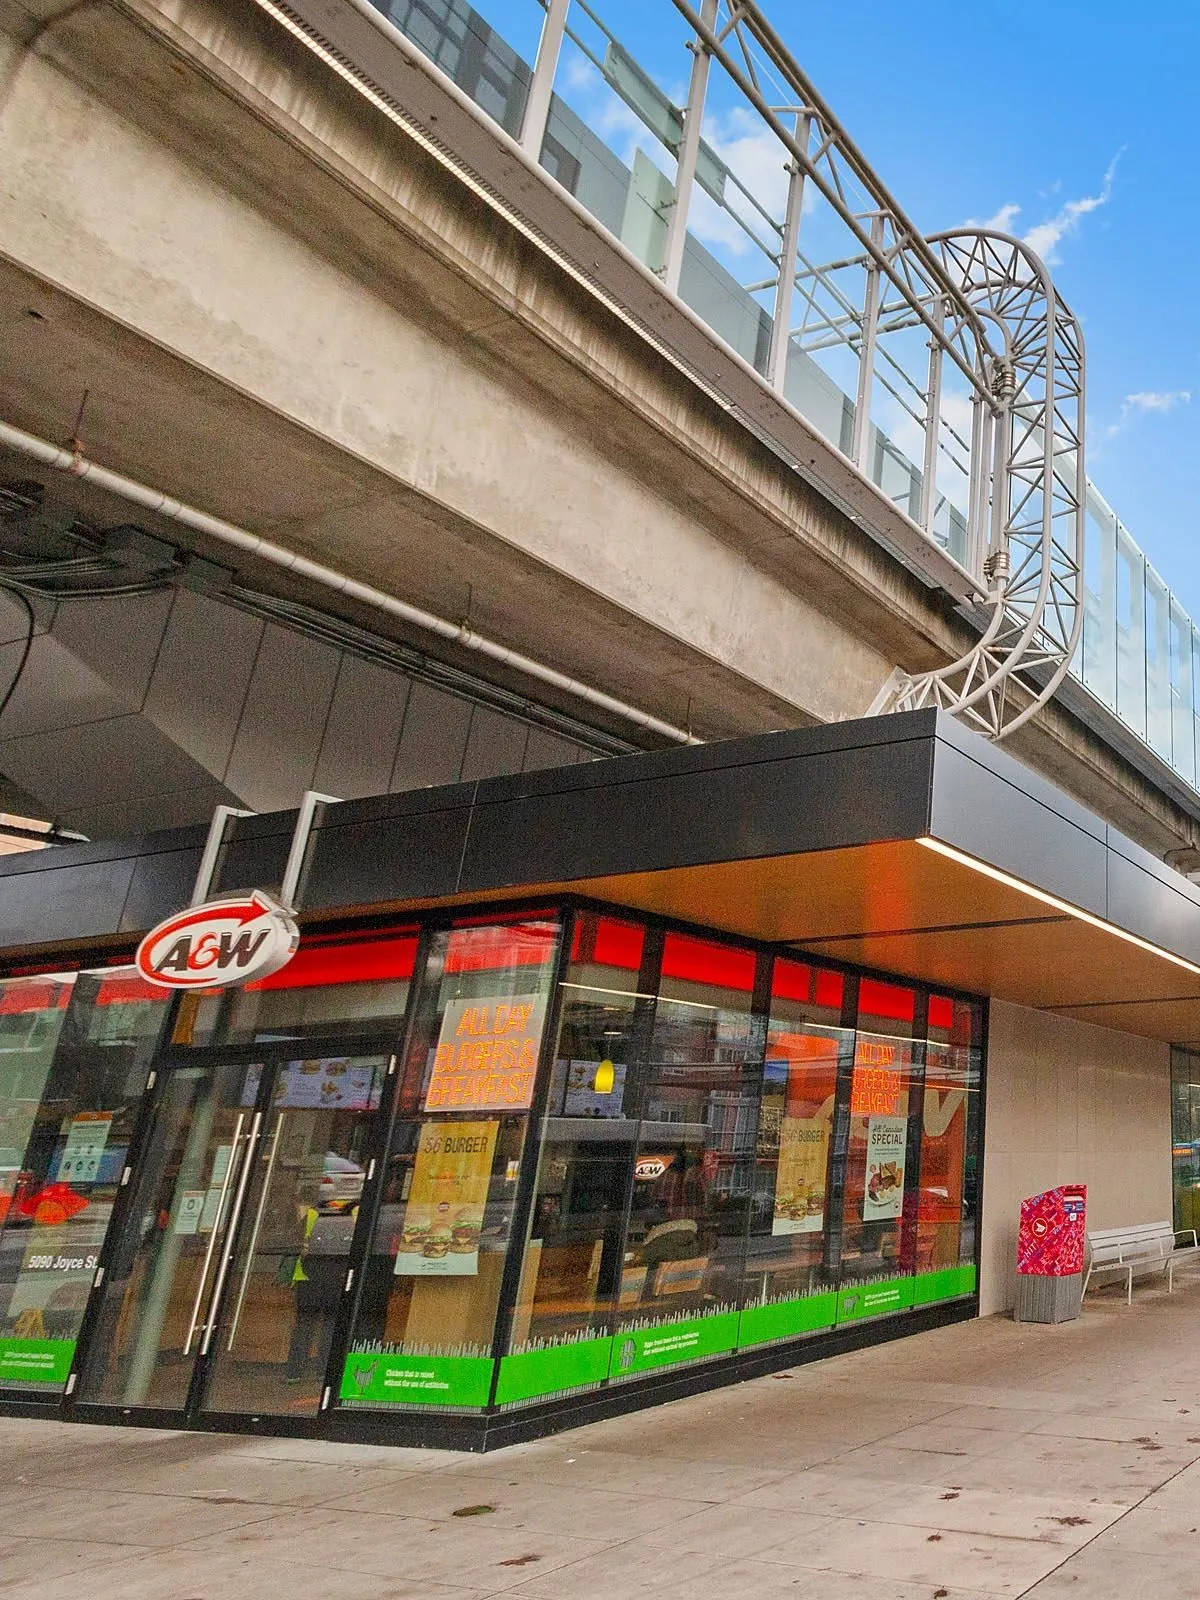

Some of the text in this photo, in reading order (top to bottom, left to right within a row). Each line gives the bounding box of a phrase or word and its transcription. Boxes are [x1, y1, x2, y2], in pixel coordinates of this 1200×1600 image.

[153, 929, 272, 973] A&W
[456, 1003, 534, 1036] ALL DAY
[444, 1136, 489, 1154] BURGER
[871, 1133, 903, 1145] SPECIAL
[28, 1255, 53, 1269] 5090
[53, 1256, 83, 1272] Joyce
